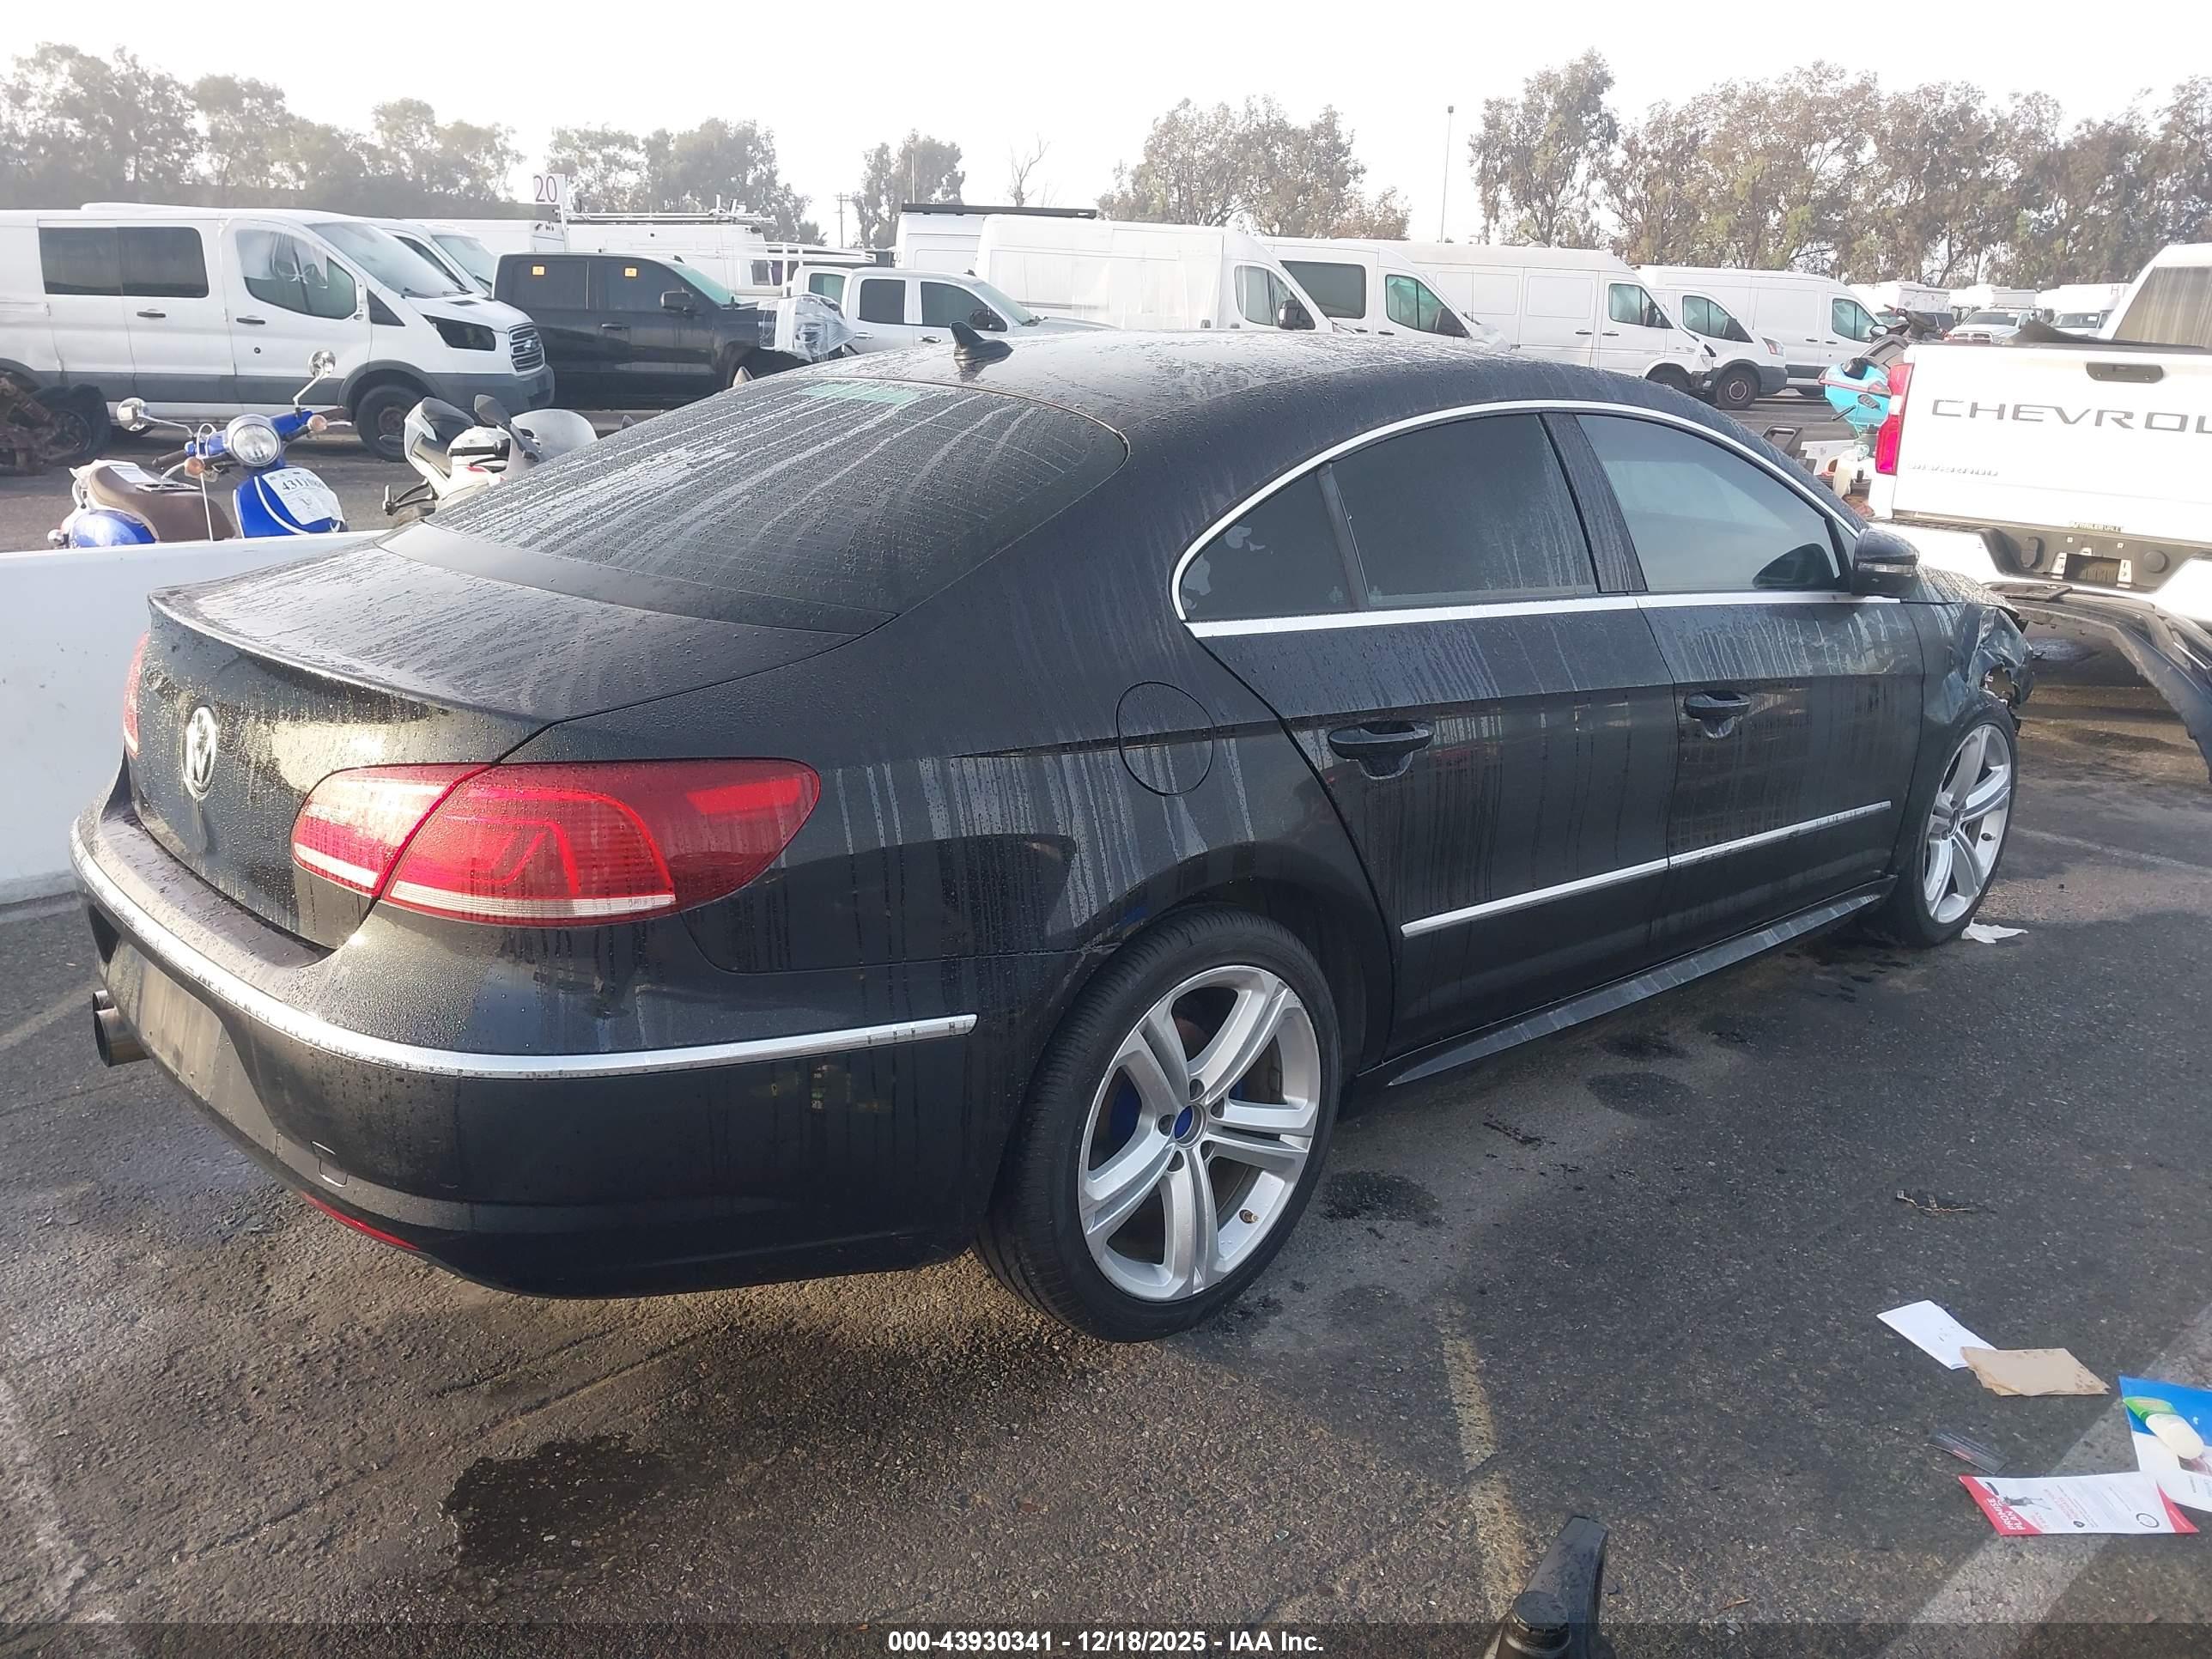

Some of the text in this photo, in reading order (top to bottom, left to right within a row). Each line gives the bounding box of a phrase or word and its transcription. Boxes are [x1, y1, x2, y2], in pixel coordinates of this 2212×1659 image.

[533, 174, 557, 203] 20
[1986, 1498, 2017, 1530] PROMISE
[2004, 1510, 2027, 1530] PLAN
